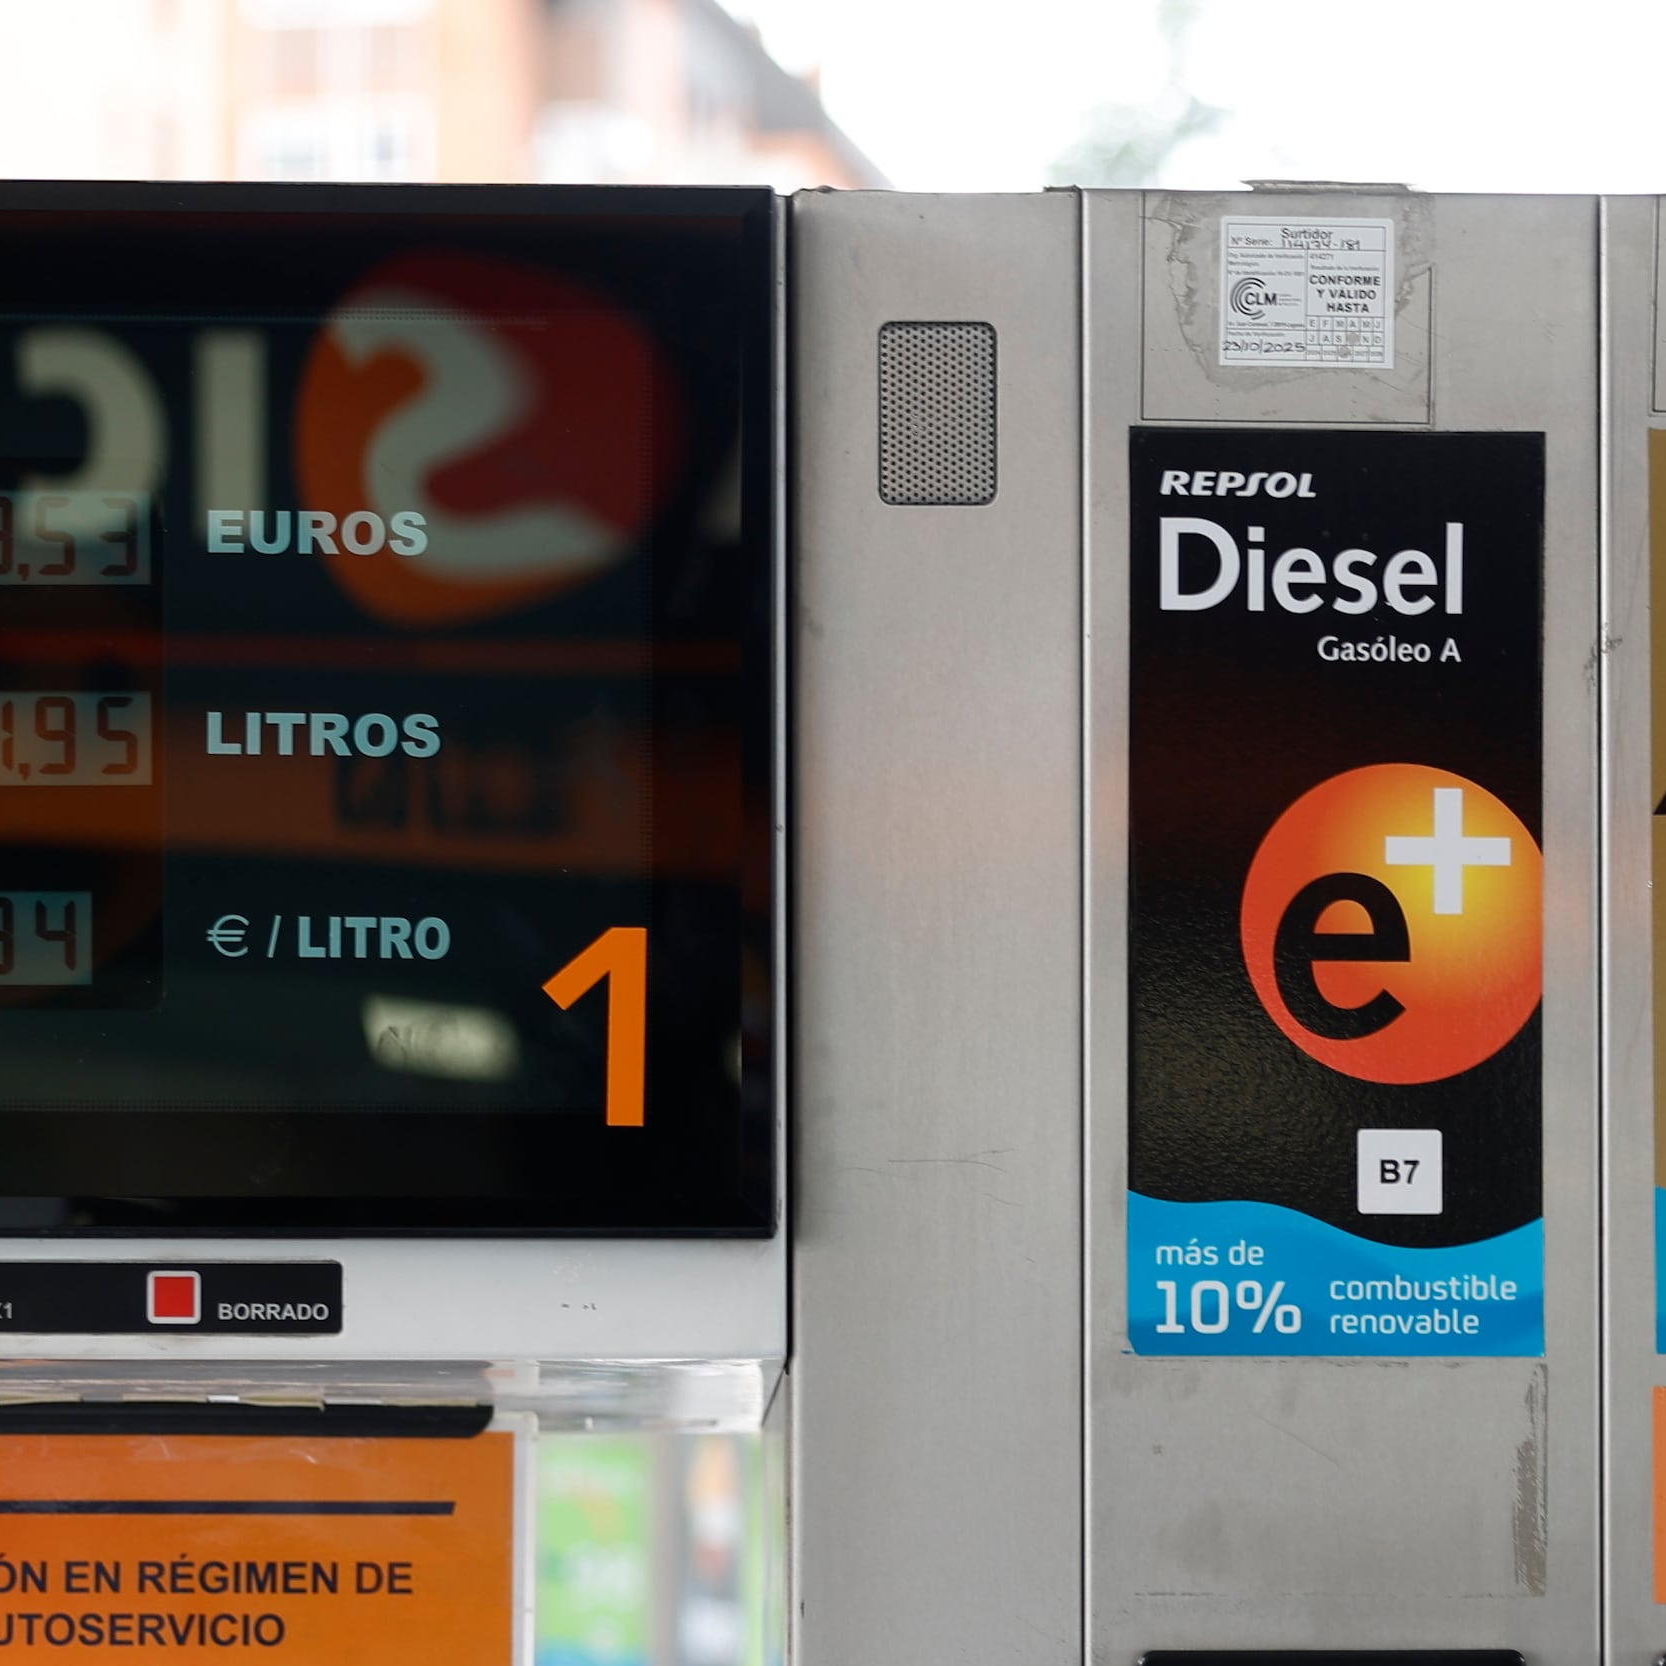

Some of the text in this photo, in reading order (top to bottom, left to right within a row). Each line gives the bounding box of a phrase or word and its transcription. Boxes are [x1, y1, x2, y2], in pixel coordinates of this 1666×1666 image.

[1281, 228, 1333, 239] Surtidor
[1309, 276, 1381, 286] CONFORME
[1317, 289, 1325, 298] Y
[1245, 293, 1278, 306] CLM
[1326, 303, 1370, 313] HASTA
[1160, 470, 1317, 498] REPSOL
[206, 510, 429, 558] EUROS
[1160, 517, 1464, 615] Diesel
[1317, 635, 1461, 663] Gasóleo A
[204, 711, 442, 759] LITROS
[205, 913, 452, 962] € LITRO
[541, 926, 647, 1127] 1
[1378, 1159, 1420, 1185] B7
[1156, 1238, 1264, 1266] más de
[1329, 1274, 1518, 1302] combustible
[218, 1302, 330, 1323] BORRADO
[1155, 1280, 1302, 1336] 10%
[1329, 1308, 1480, 1336] renovable
[65, 1560, 121, 1594] EN
[138, 1554, 339, 1596] RÉGIMEN
[355, 1561, 414, 1596] DE
